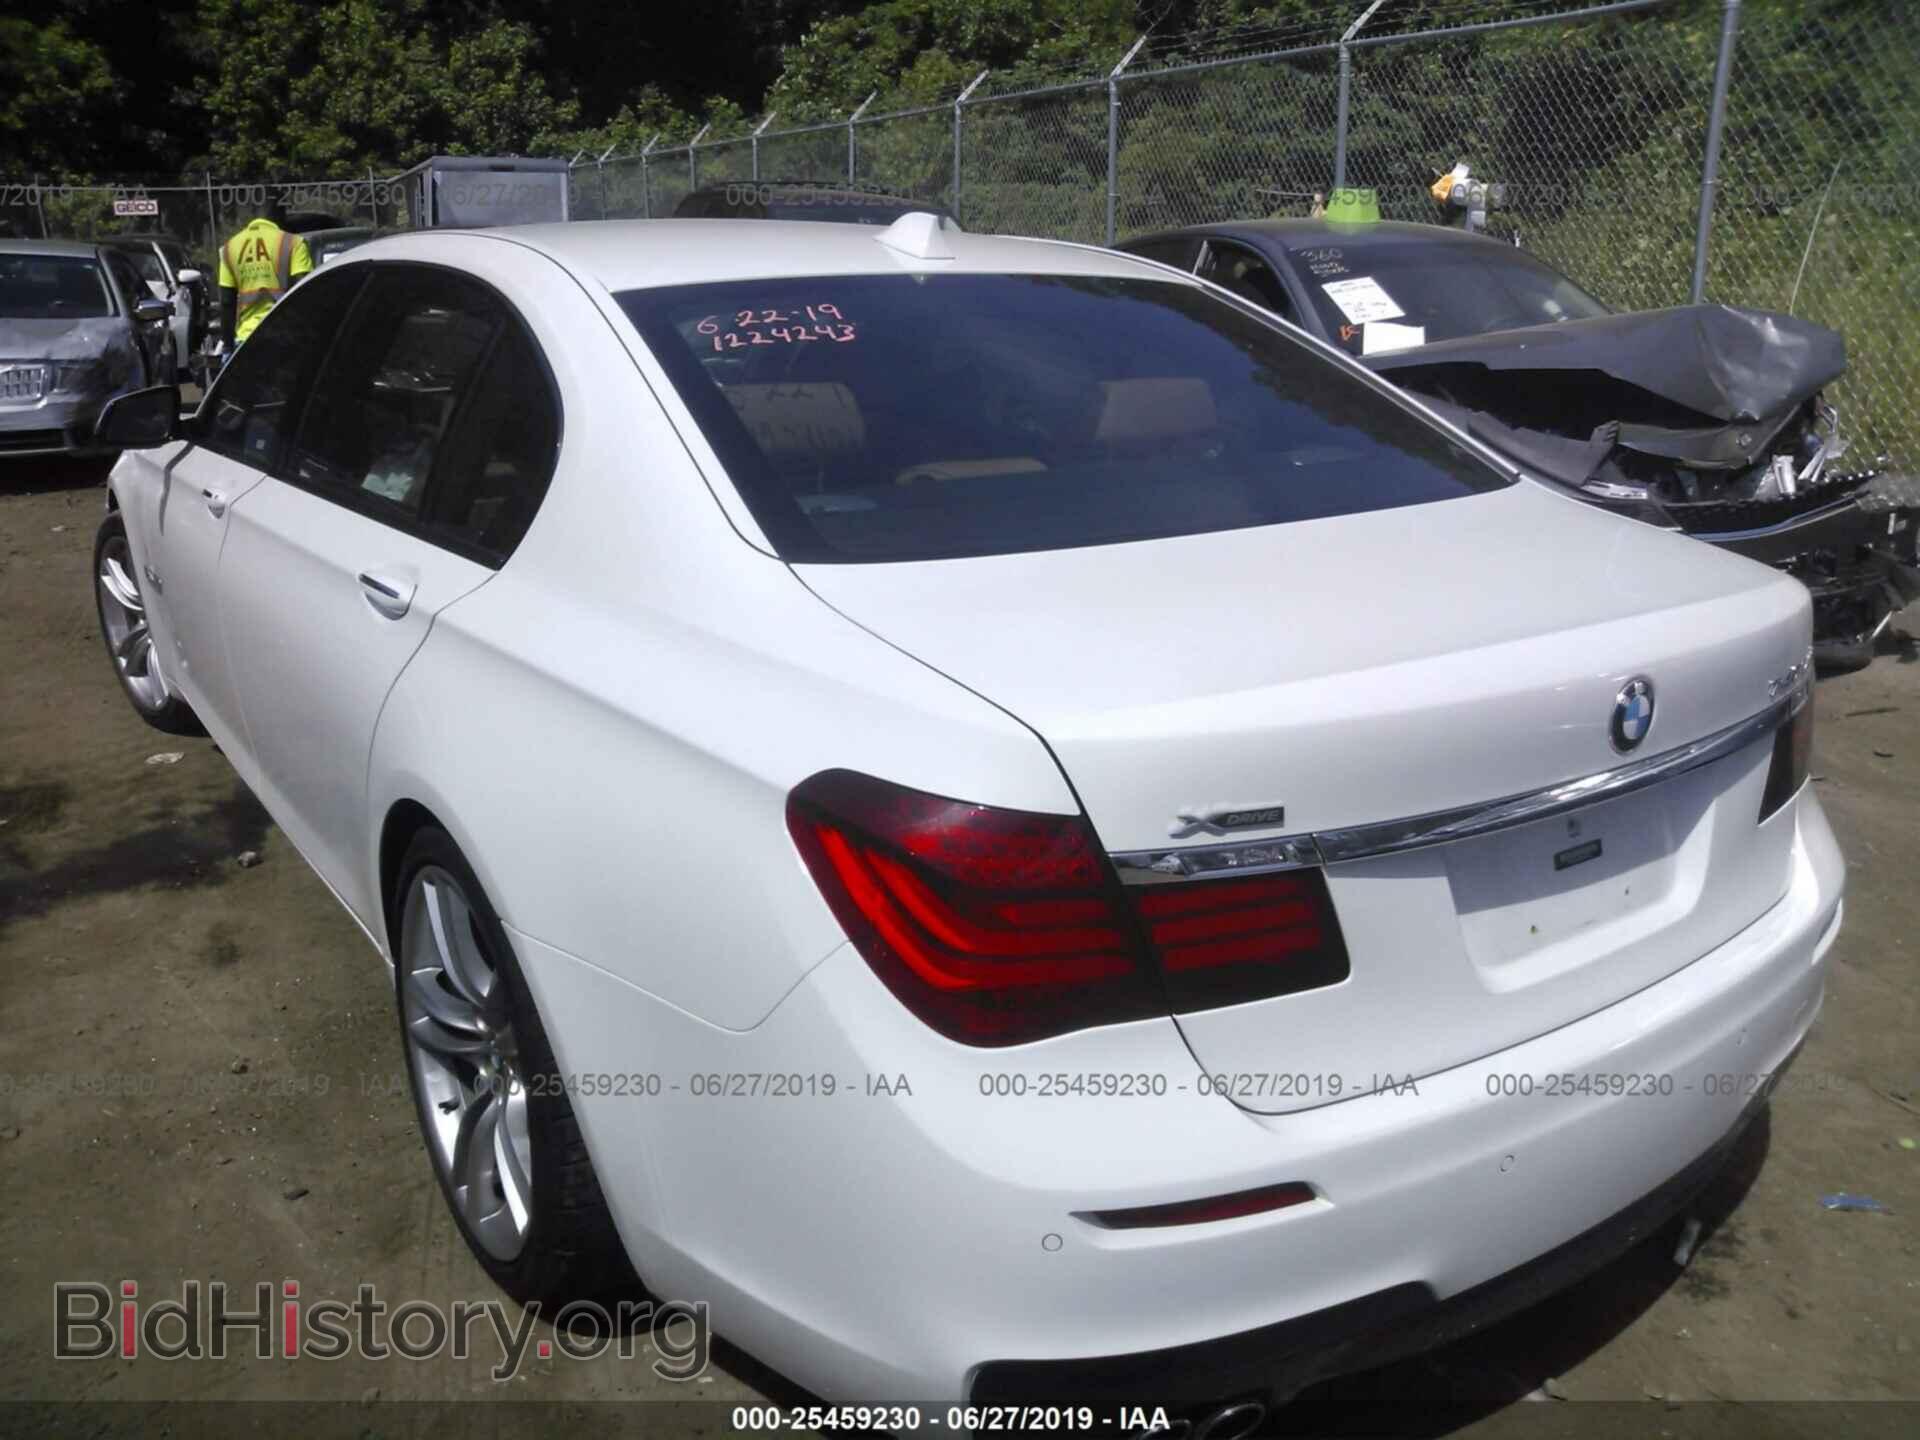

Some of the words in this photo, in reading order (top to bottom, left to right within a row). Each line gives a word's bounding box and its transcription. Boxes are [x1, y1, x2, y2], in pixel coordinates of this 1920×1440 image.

[116, 203, 155, 213] GEICO
[697, 315, 718, 334] 6
[713, 323, 857, 352] 1224243
